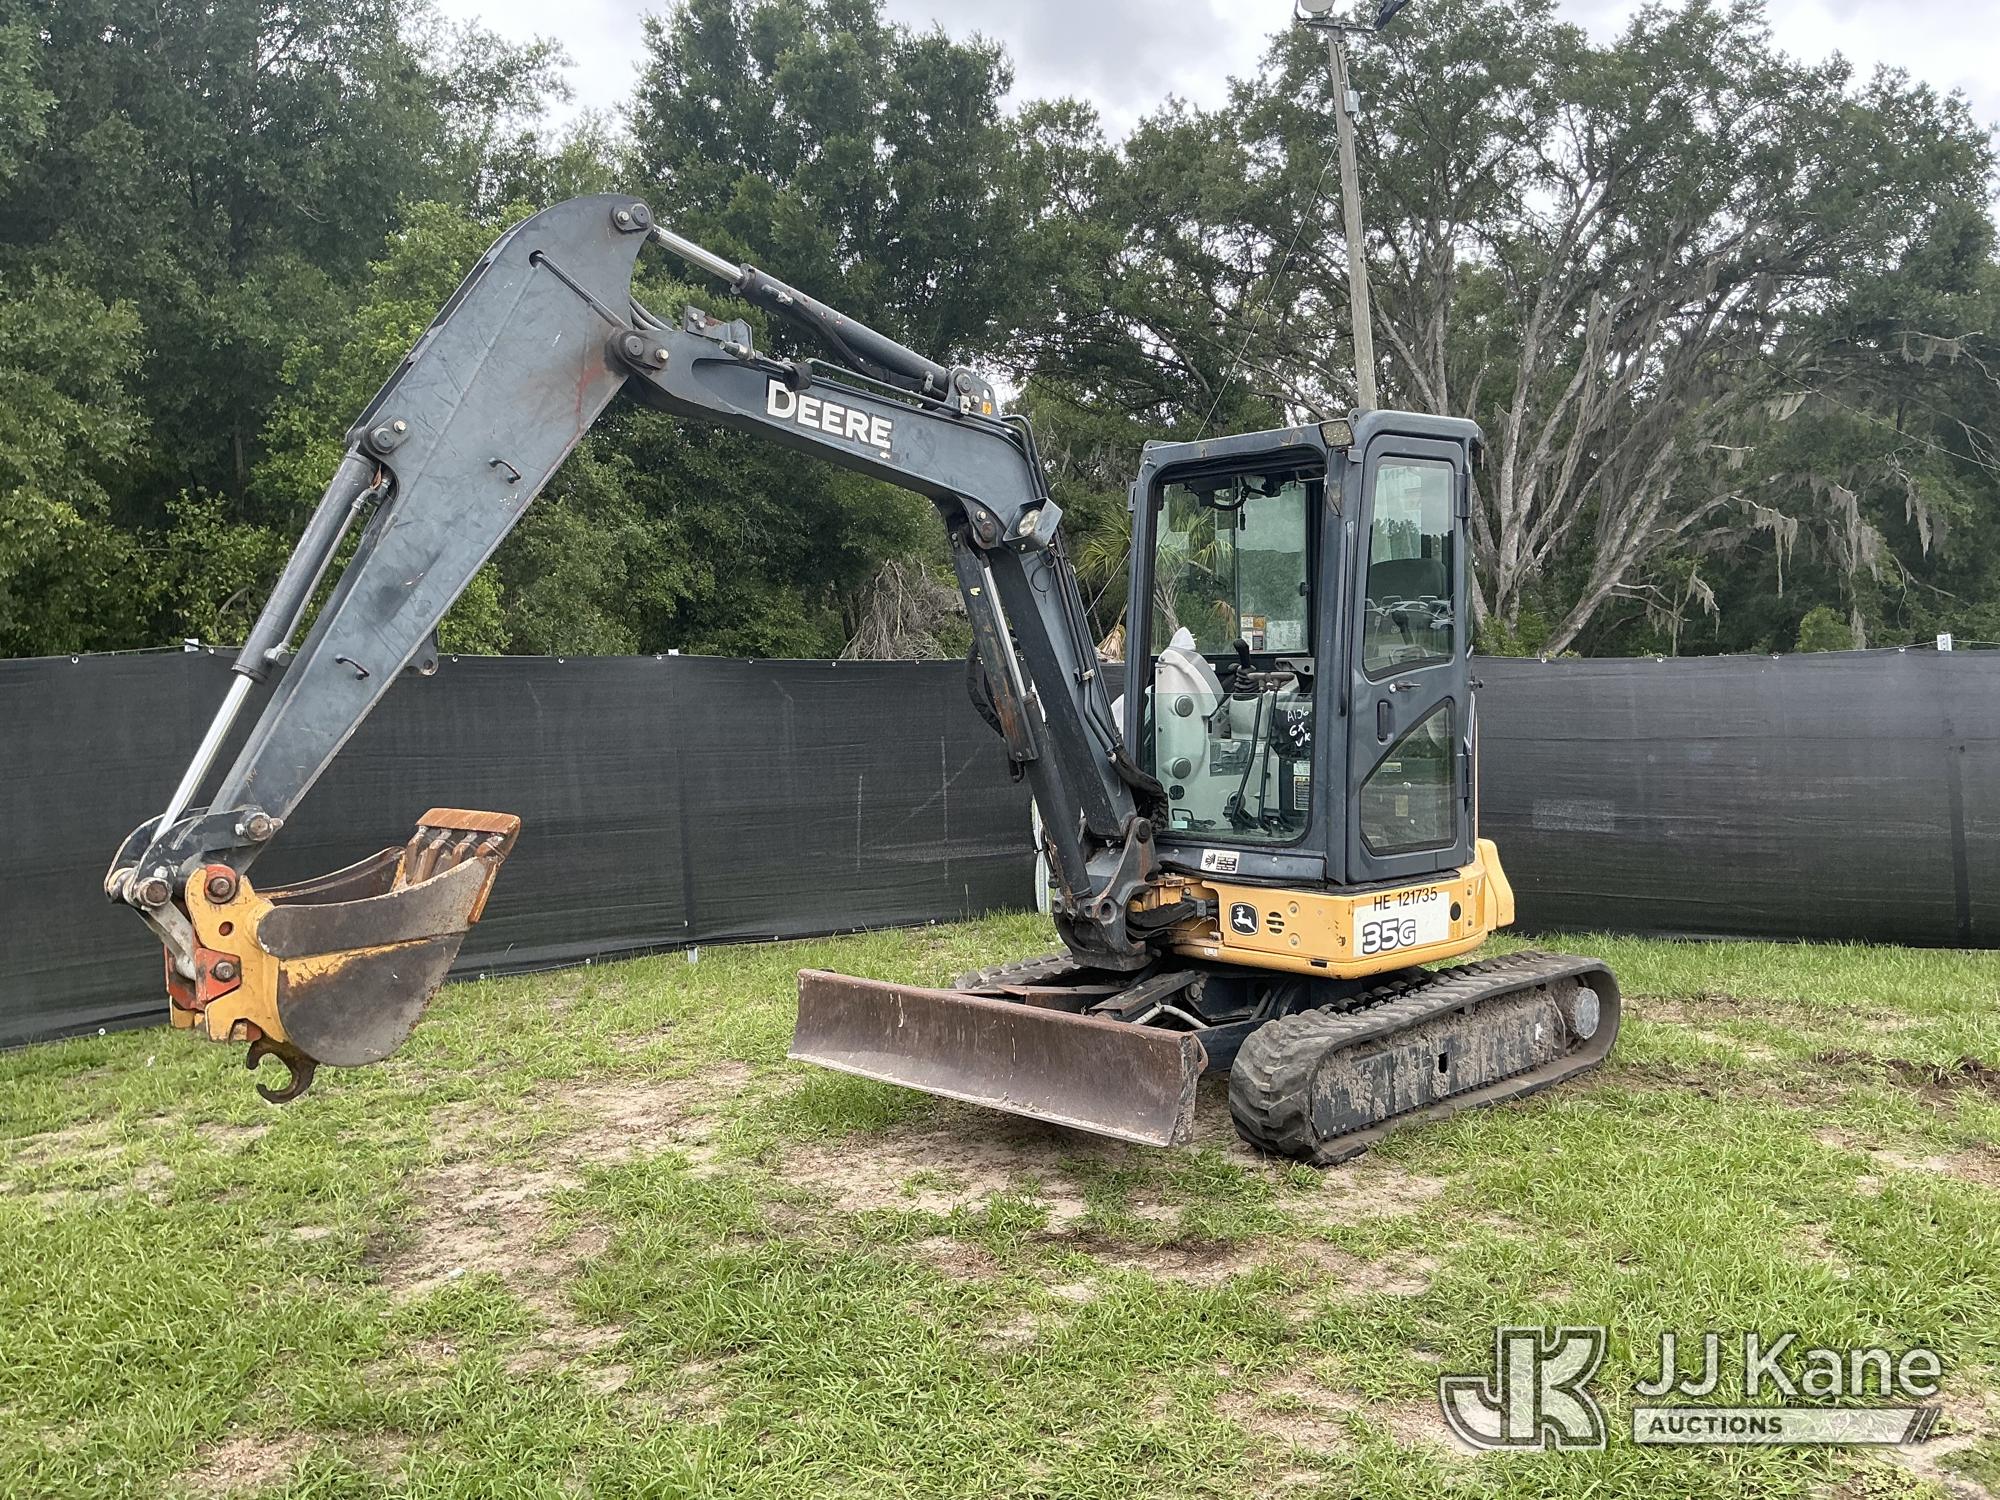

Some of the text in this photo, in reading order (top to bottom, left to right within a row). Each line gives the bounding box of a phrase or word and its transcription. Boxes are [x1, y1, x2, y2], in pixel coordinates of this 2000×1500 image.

[767, 379, 893, 449] DEERE
[1373, 886, 1438, 911] HE 121735
[1362, 917, 1416, 954] 35G
